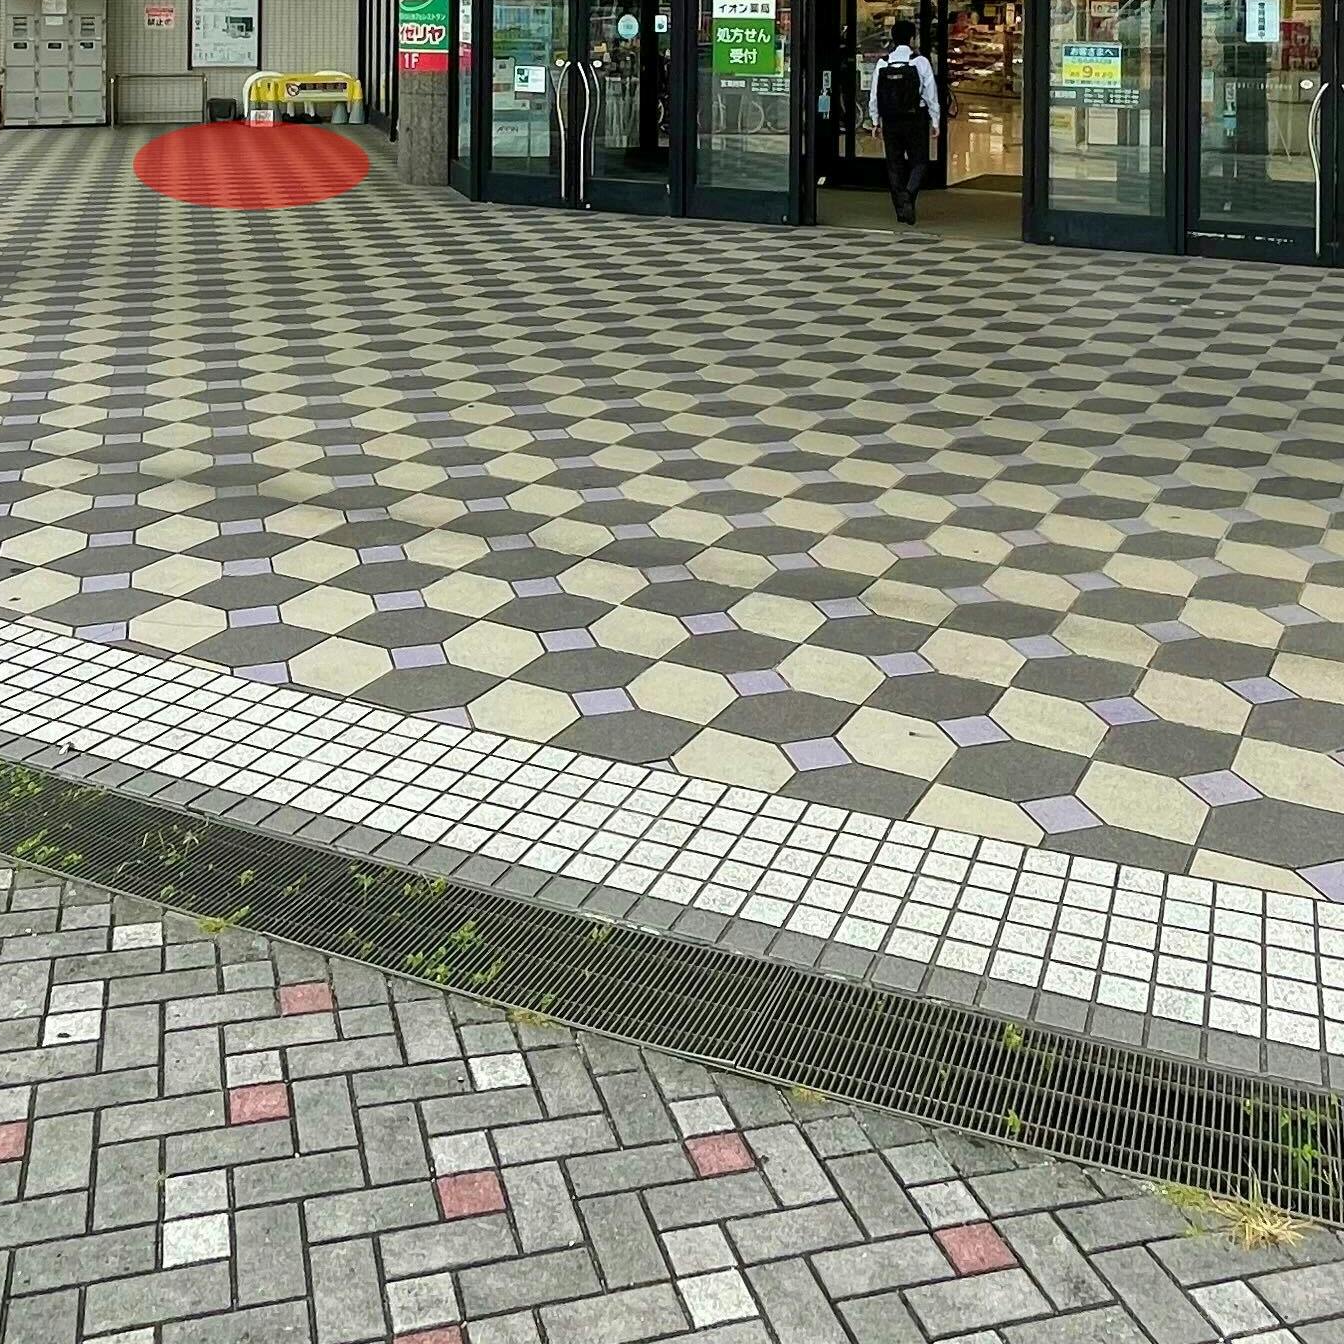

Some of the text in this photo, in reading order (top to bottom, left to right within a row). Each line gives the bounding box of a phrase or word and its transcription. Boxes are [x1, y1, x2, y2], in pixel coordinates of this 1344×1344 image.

[718, 3, 771, 15] イオン薬局
[716, 27, 771, 44] 処方せん
[403, 53, 420, 70] 1F
[729, 48, 758, 64] 受付
